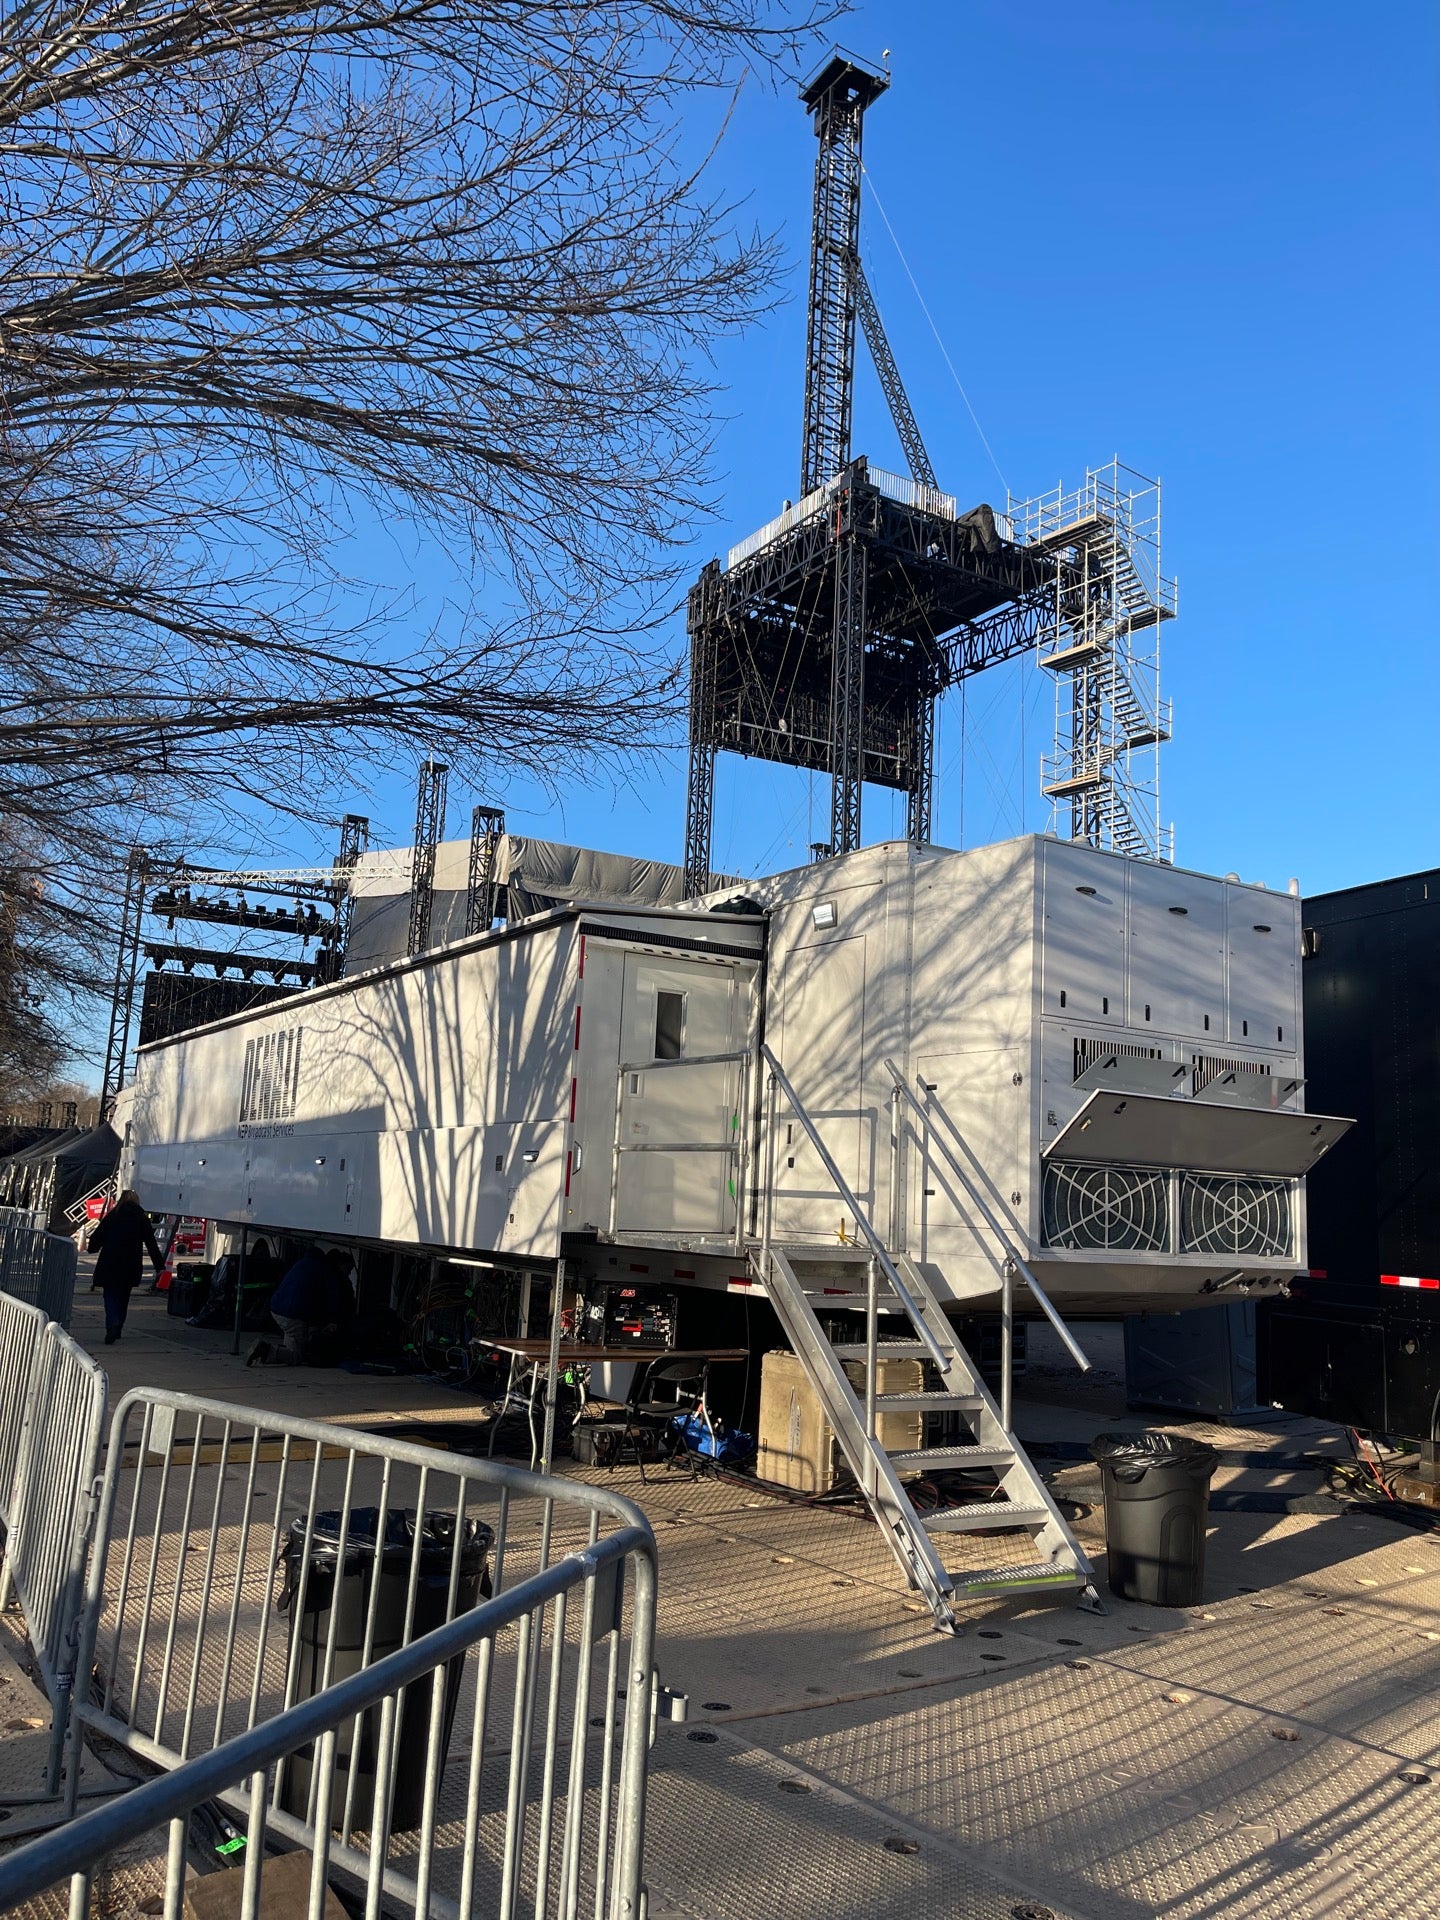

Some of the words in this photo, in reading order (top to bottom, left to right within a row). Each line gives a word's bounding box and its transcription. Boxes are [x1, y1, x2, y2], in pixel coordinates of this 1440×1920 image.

[239, 1026, 303, 1122] DENALI
[238, 1125, 248, 1139] NEP
[248, 1125, 272, 1138] Broadcast
[273, 1124, 294, 1137] Services
